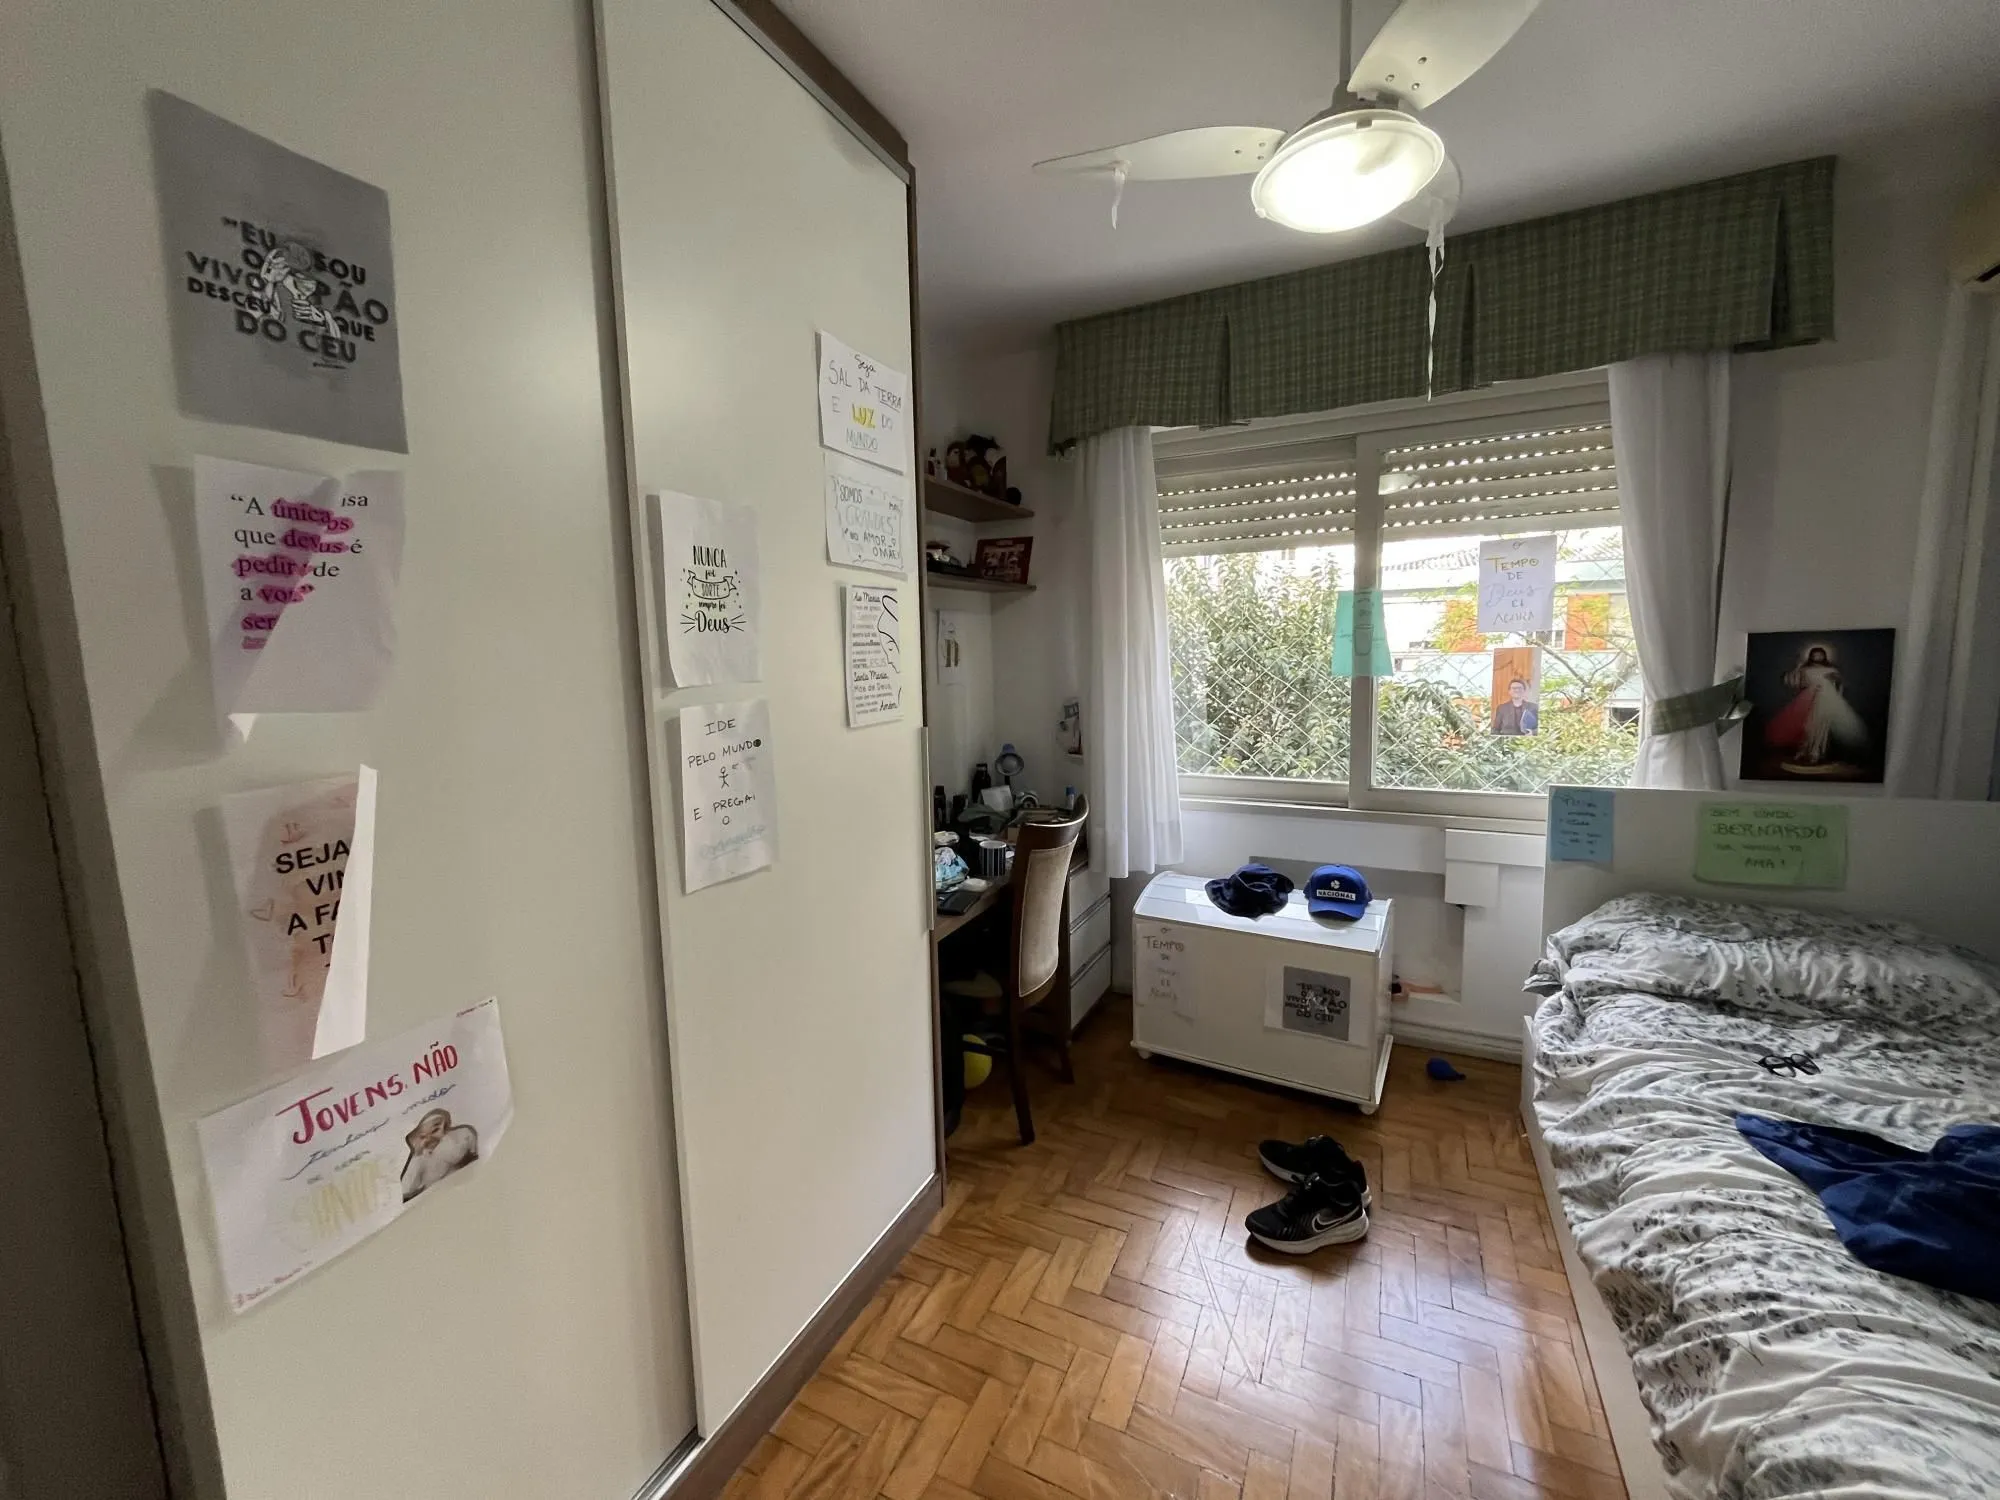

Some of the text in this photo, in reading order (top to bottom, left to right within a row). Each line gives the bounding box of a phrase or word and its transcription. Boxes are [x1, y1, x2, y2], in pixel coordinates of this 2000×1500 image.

[313, 250, 367, 285] SOU
[186, 250, 376, 342] VIVO QUE
[188, 276, 271, 314] DESCEU
[243, 247, 389, 325] O PÃO
[235, 309, 288, 343] DO
[828, 359, 902, 409] SAL DA TERRA
[852, 403, 876, 429] LUZ
[839, 484, 863, 504] SOMOS
[273, 499, 331, 524] única
[234, 529, 276, 548] que
[350, 539, 363, 554] é
[693, 545, 727, 568] NUNCA
[1484, 556, 1540, 574] TEMPO
[313, 561, 340, 577] de
[241, 587, 253, 601] a
[701, 583, 720, 597] SORTE
[694, 610, 730, 634] Deus
[704, 718, 736, 736] IDE
[687, 751, 716, 768] PELO
[693, 808, 702, 821] E
[1713, 823, 1828, 840] BERNARDO
[275, 839, 350, 875] SEJA
[1317, 890, 1356, 900] NACIONAL
[287, 913, 308, 936] A
[1142, 936, 1185, 953] TEMPO
[412, 1041, 459, 1085] NÃO
